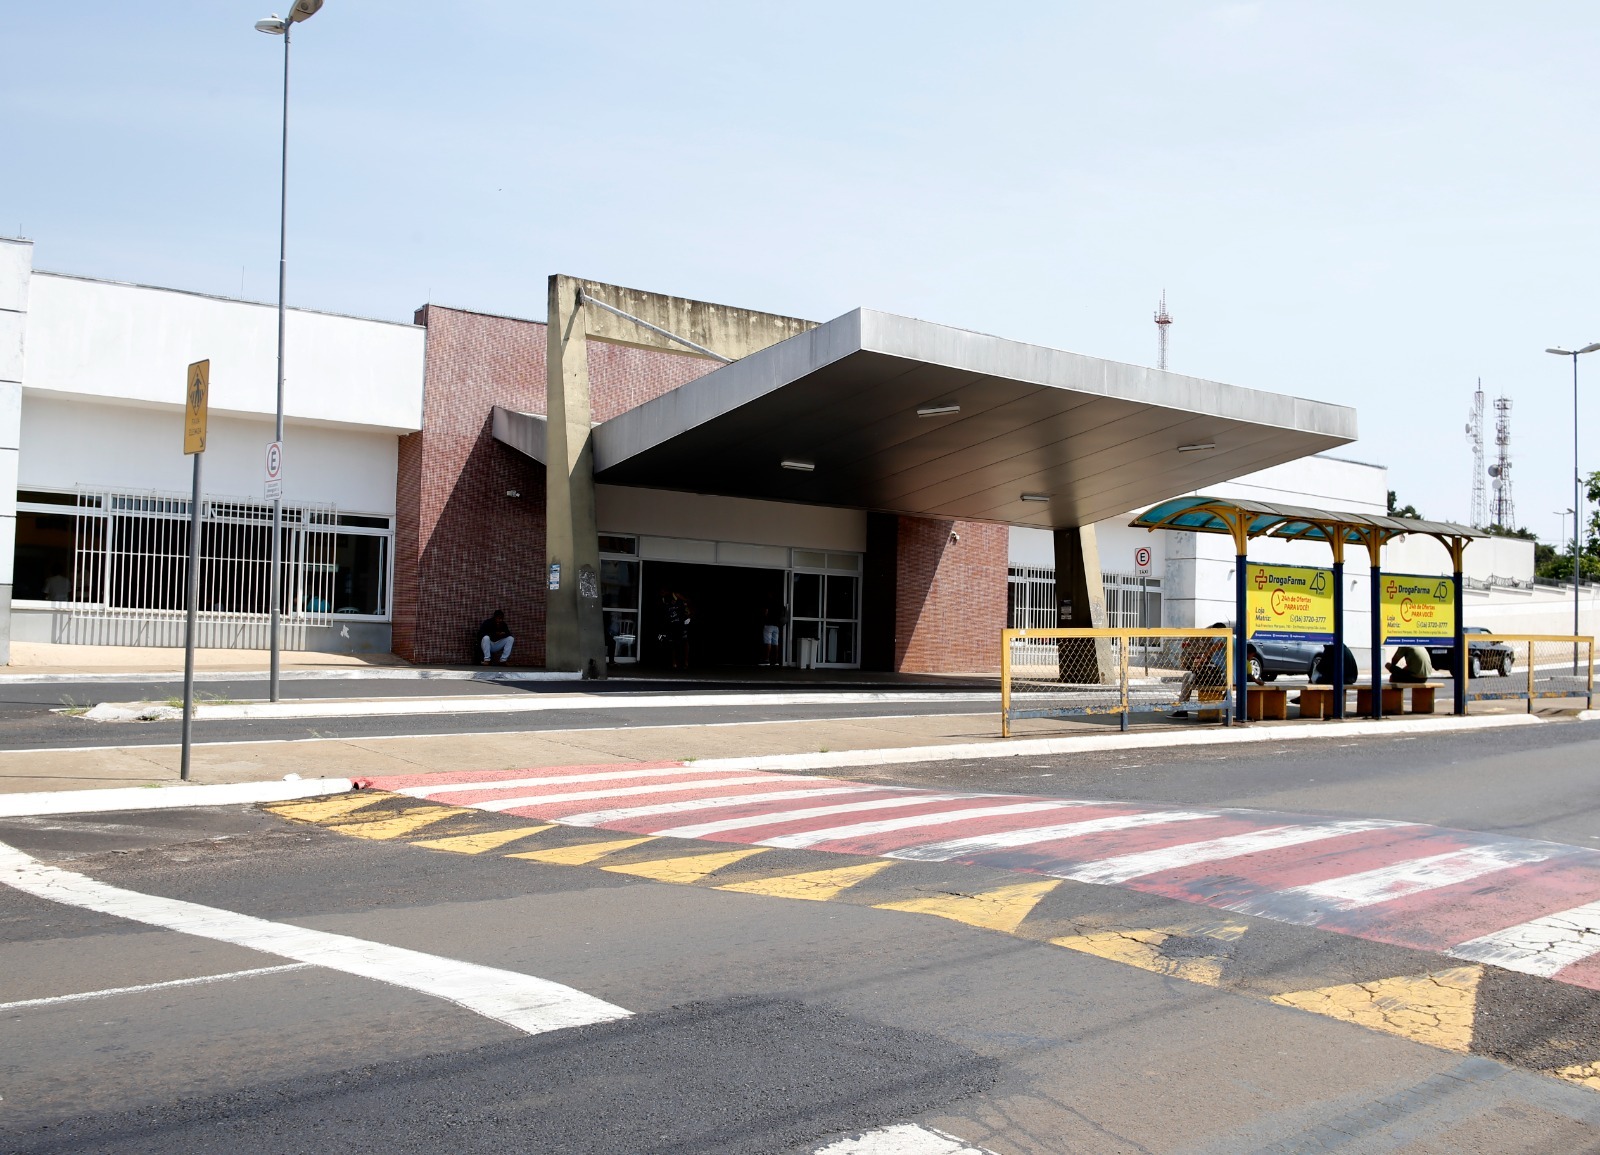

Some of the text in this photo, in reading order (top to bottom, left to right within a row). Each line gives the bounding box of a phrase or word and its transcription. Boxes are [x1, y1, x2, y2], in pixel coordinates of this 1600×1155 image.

[270, 450, 276, 470] E
[1140, 552, 1146, 562] E
[1268, 574, 1306, 586] DrogaFarma
[1310, 572, 1326, 594] 45
[1398, 585, 1430, 595] DrogaFarma
[1433, 581, 1448, 602] 45
